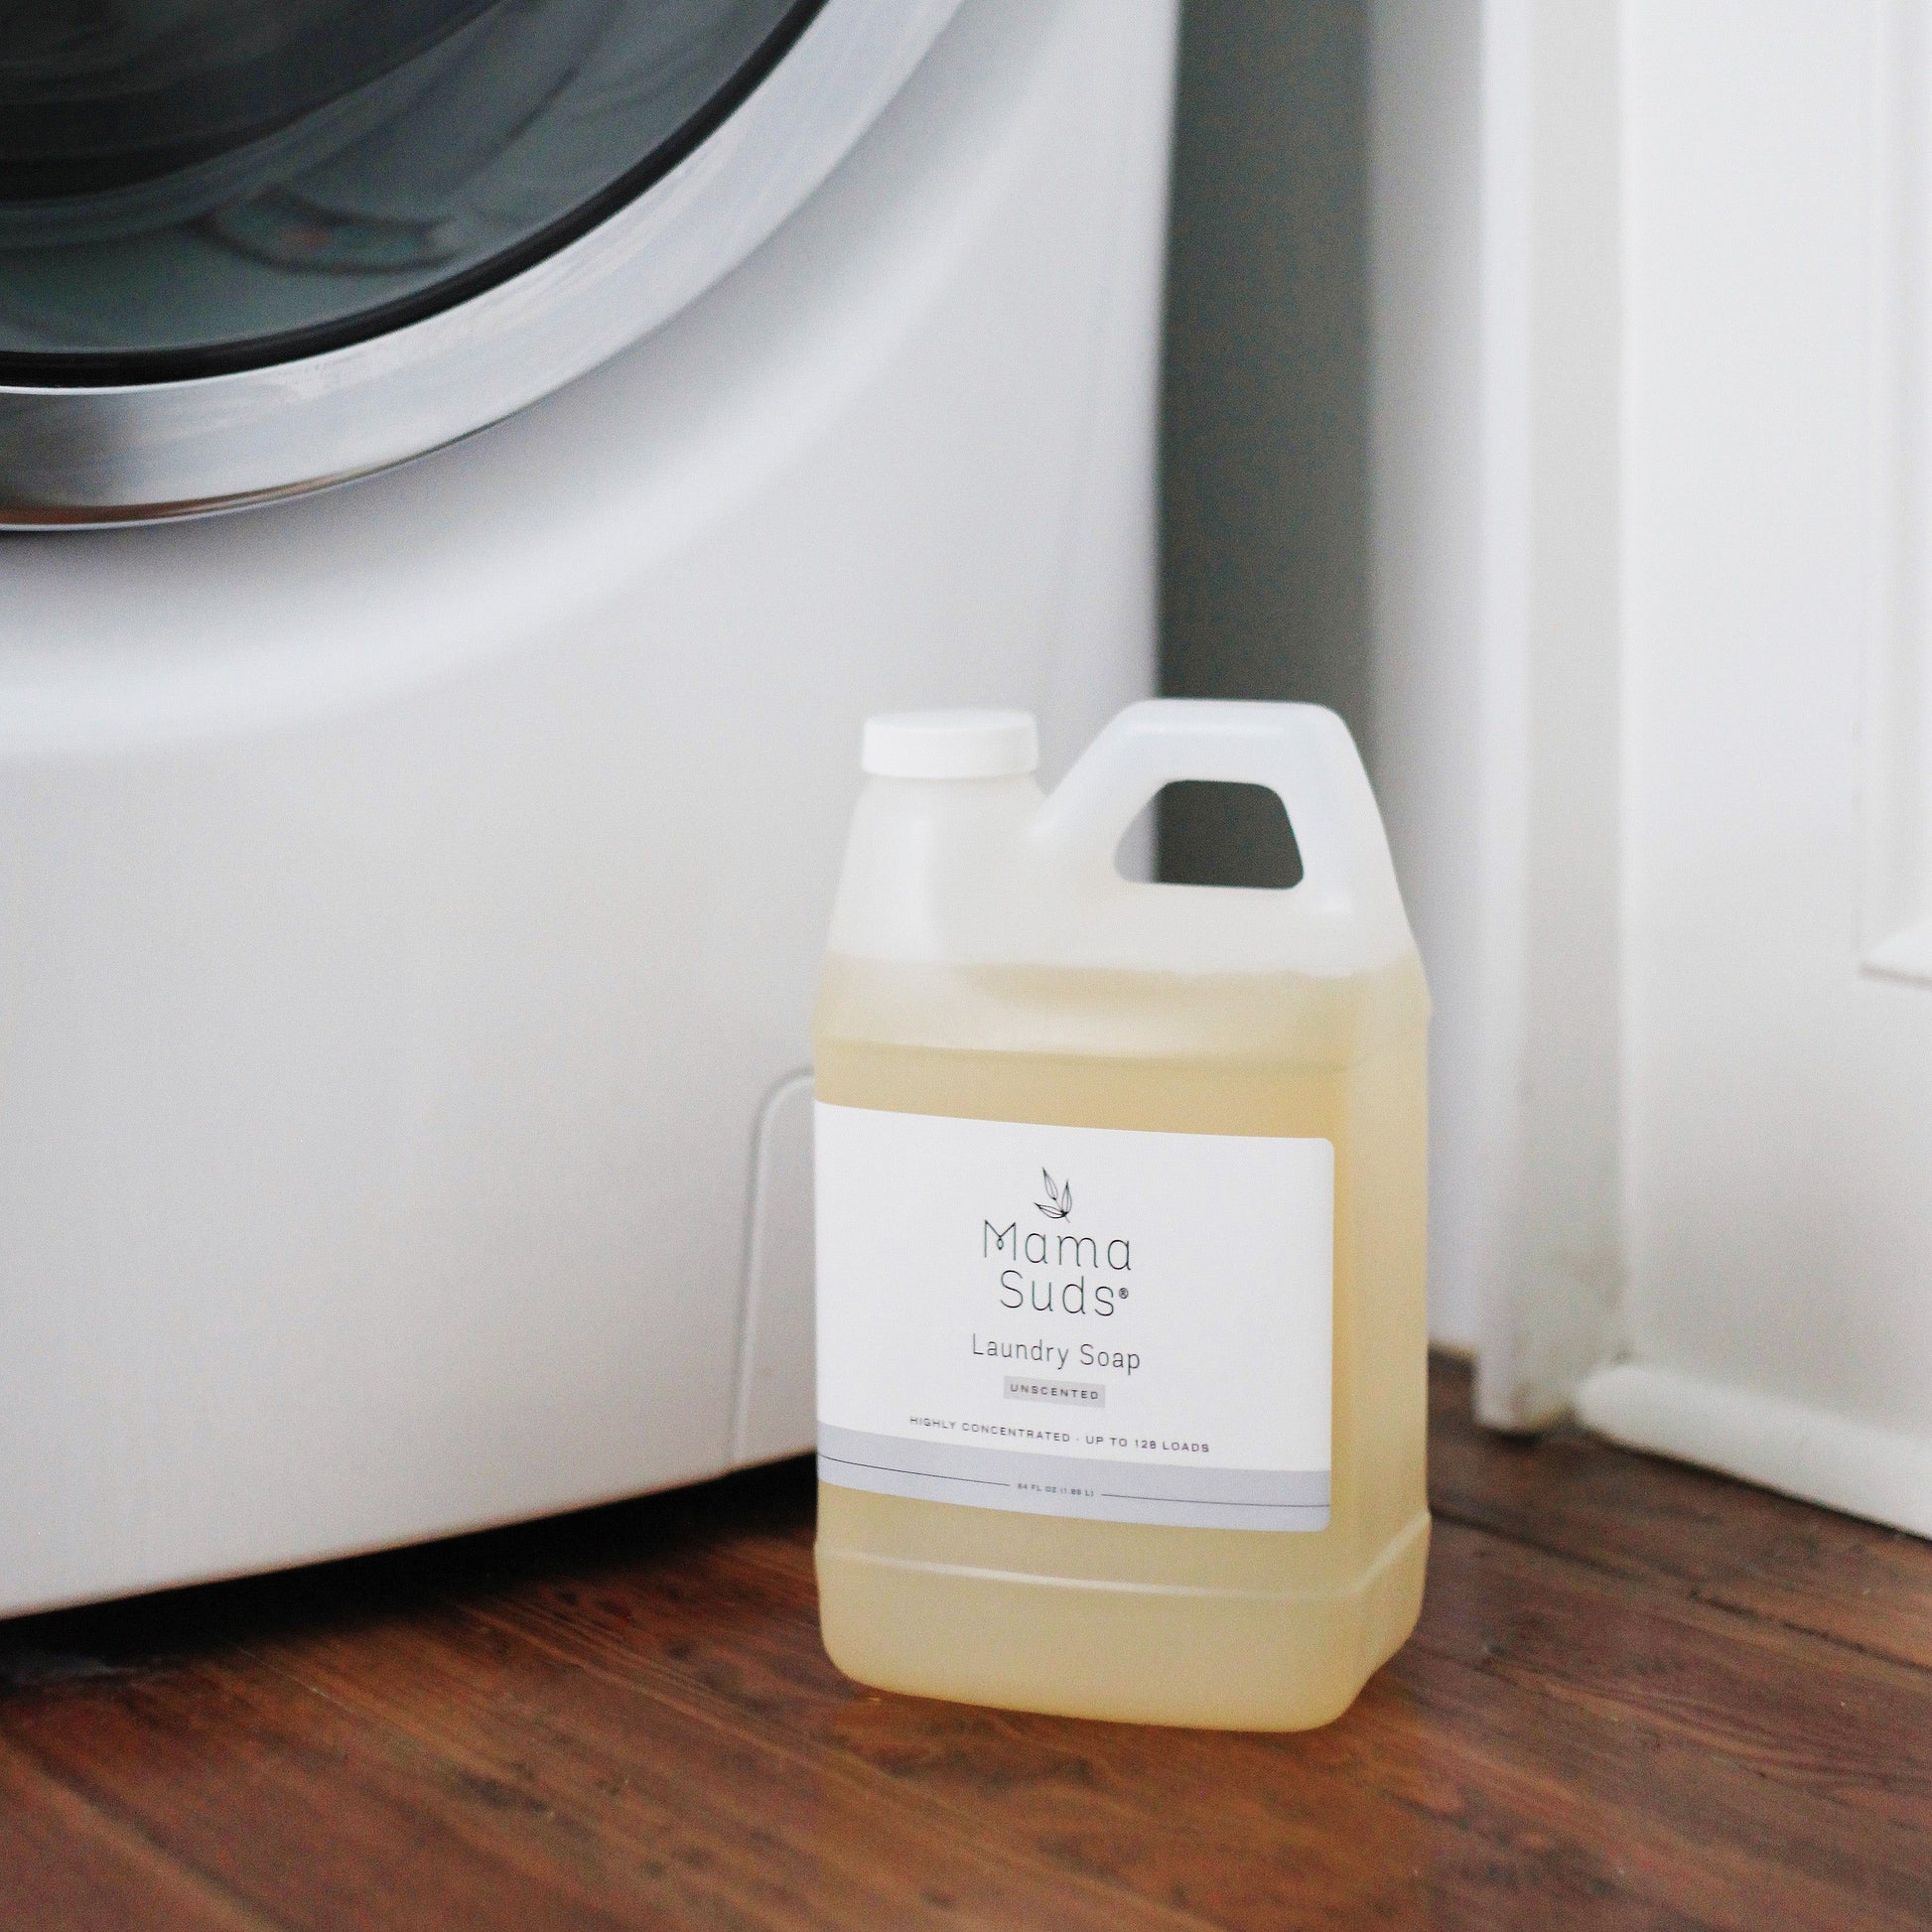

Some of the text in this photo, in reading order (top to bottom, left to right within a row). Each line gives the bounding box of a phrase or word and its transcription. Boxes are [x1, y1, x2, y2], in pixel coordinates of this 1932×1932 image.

[983, 1219, 1132, 1271] Mama
[972, 1332, 1141, 1376] Laundry Soap
[1010, 1383, 1099, 1400] UNSCENTED
[909, 1416, 1210, 1453] HIGHLY CONCENTRATED UP TO 128 LOADS
